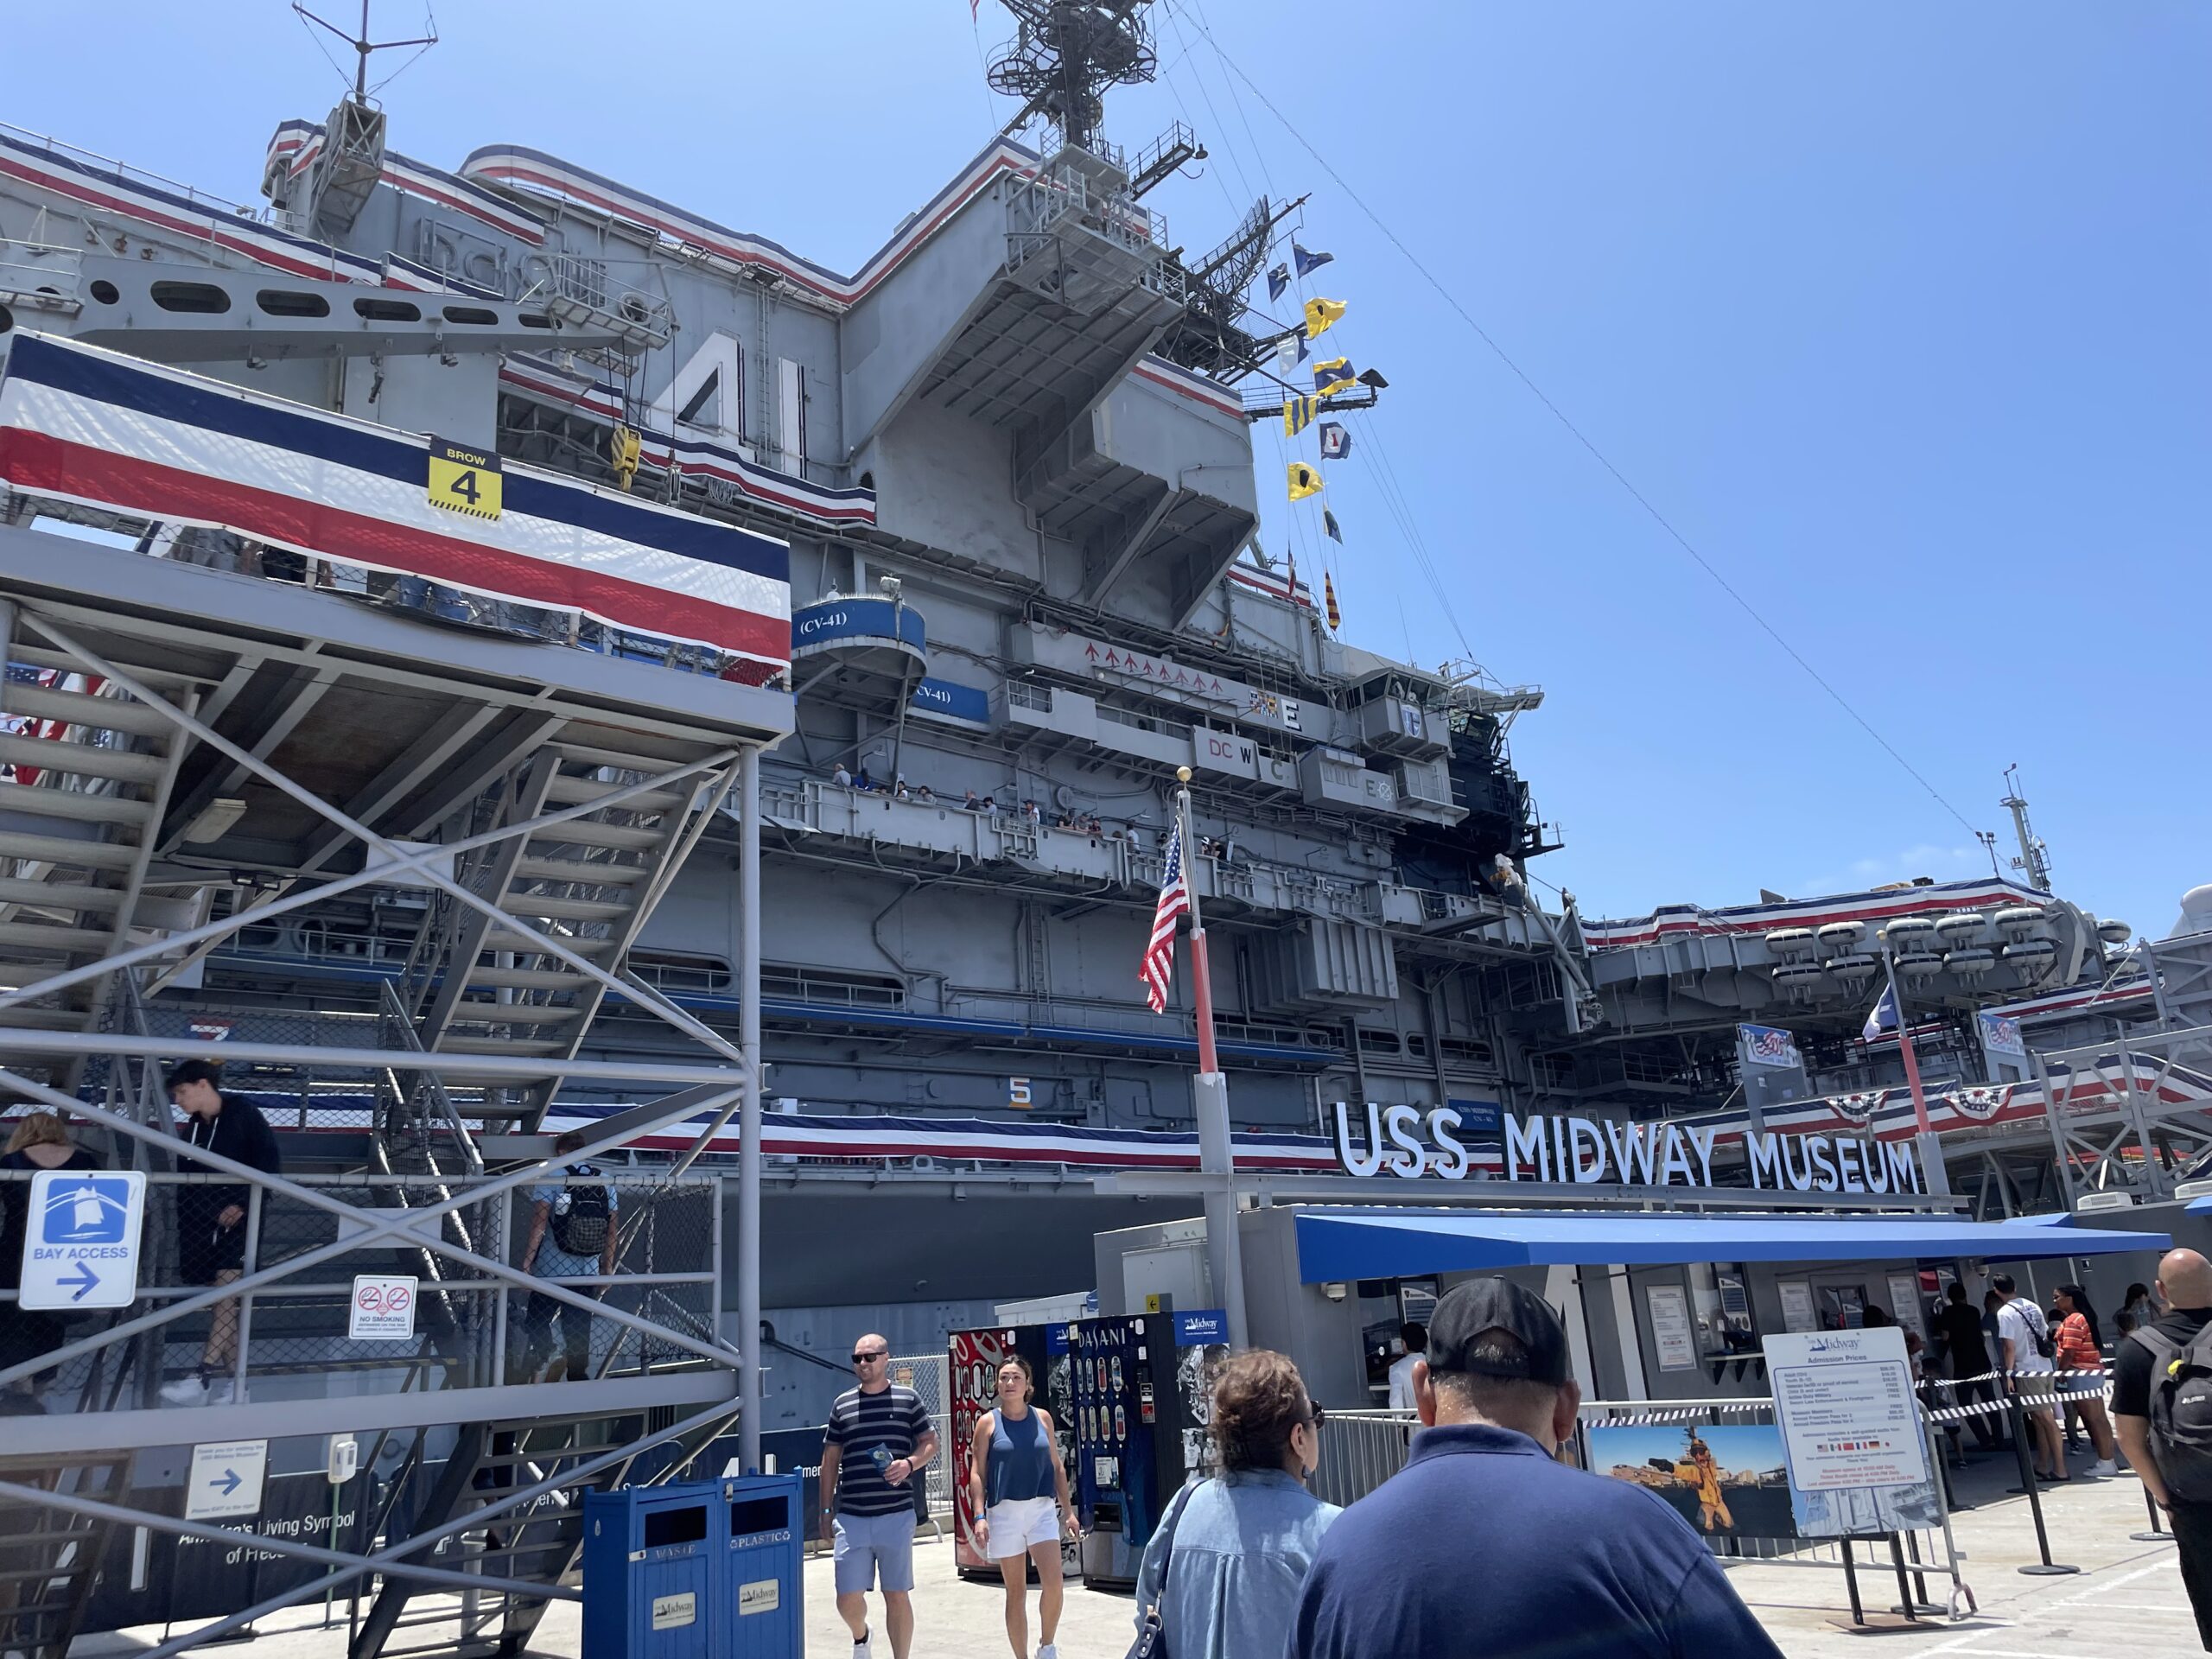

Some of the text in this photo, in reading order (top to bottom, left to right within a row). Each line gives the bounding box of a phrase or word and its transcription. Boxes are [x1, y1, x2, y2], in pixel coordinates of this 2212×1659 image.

[646, 331, 807, 480] 41
[447, 448, 486, 466] BROW
[451, 470, 480, 505] 4
[800, 612, 848, 635] (CV-41)
[916, 685, 950, 703] CV-41)
[1281, 698, 1301, 732] E
[1209, 738, 1251, 765] DC W
[1010, 1077, 1031, 1103] 5
[1332, 1102, 1919, 1195] USS MIDWAY MUSEUM
[34, 1247, 129, 1259] BAY ACCESS
[1190, 1318, 1217, 1329] Midway
[1078, 1325, 1126, 1351] DASANI
[1816, 1338, 1859, 1350] Midway
[739, 1533, 782, 1548] PLASTIC
[747, 1587, 778, 1600] Midway
[660, 1601, 693, 1614] Midway
